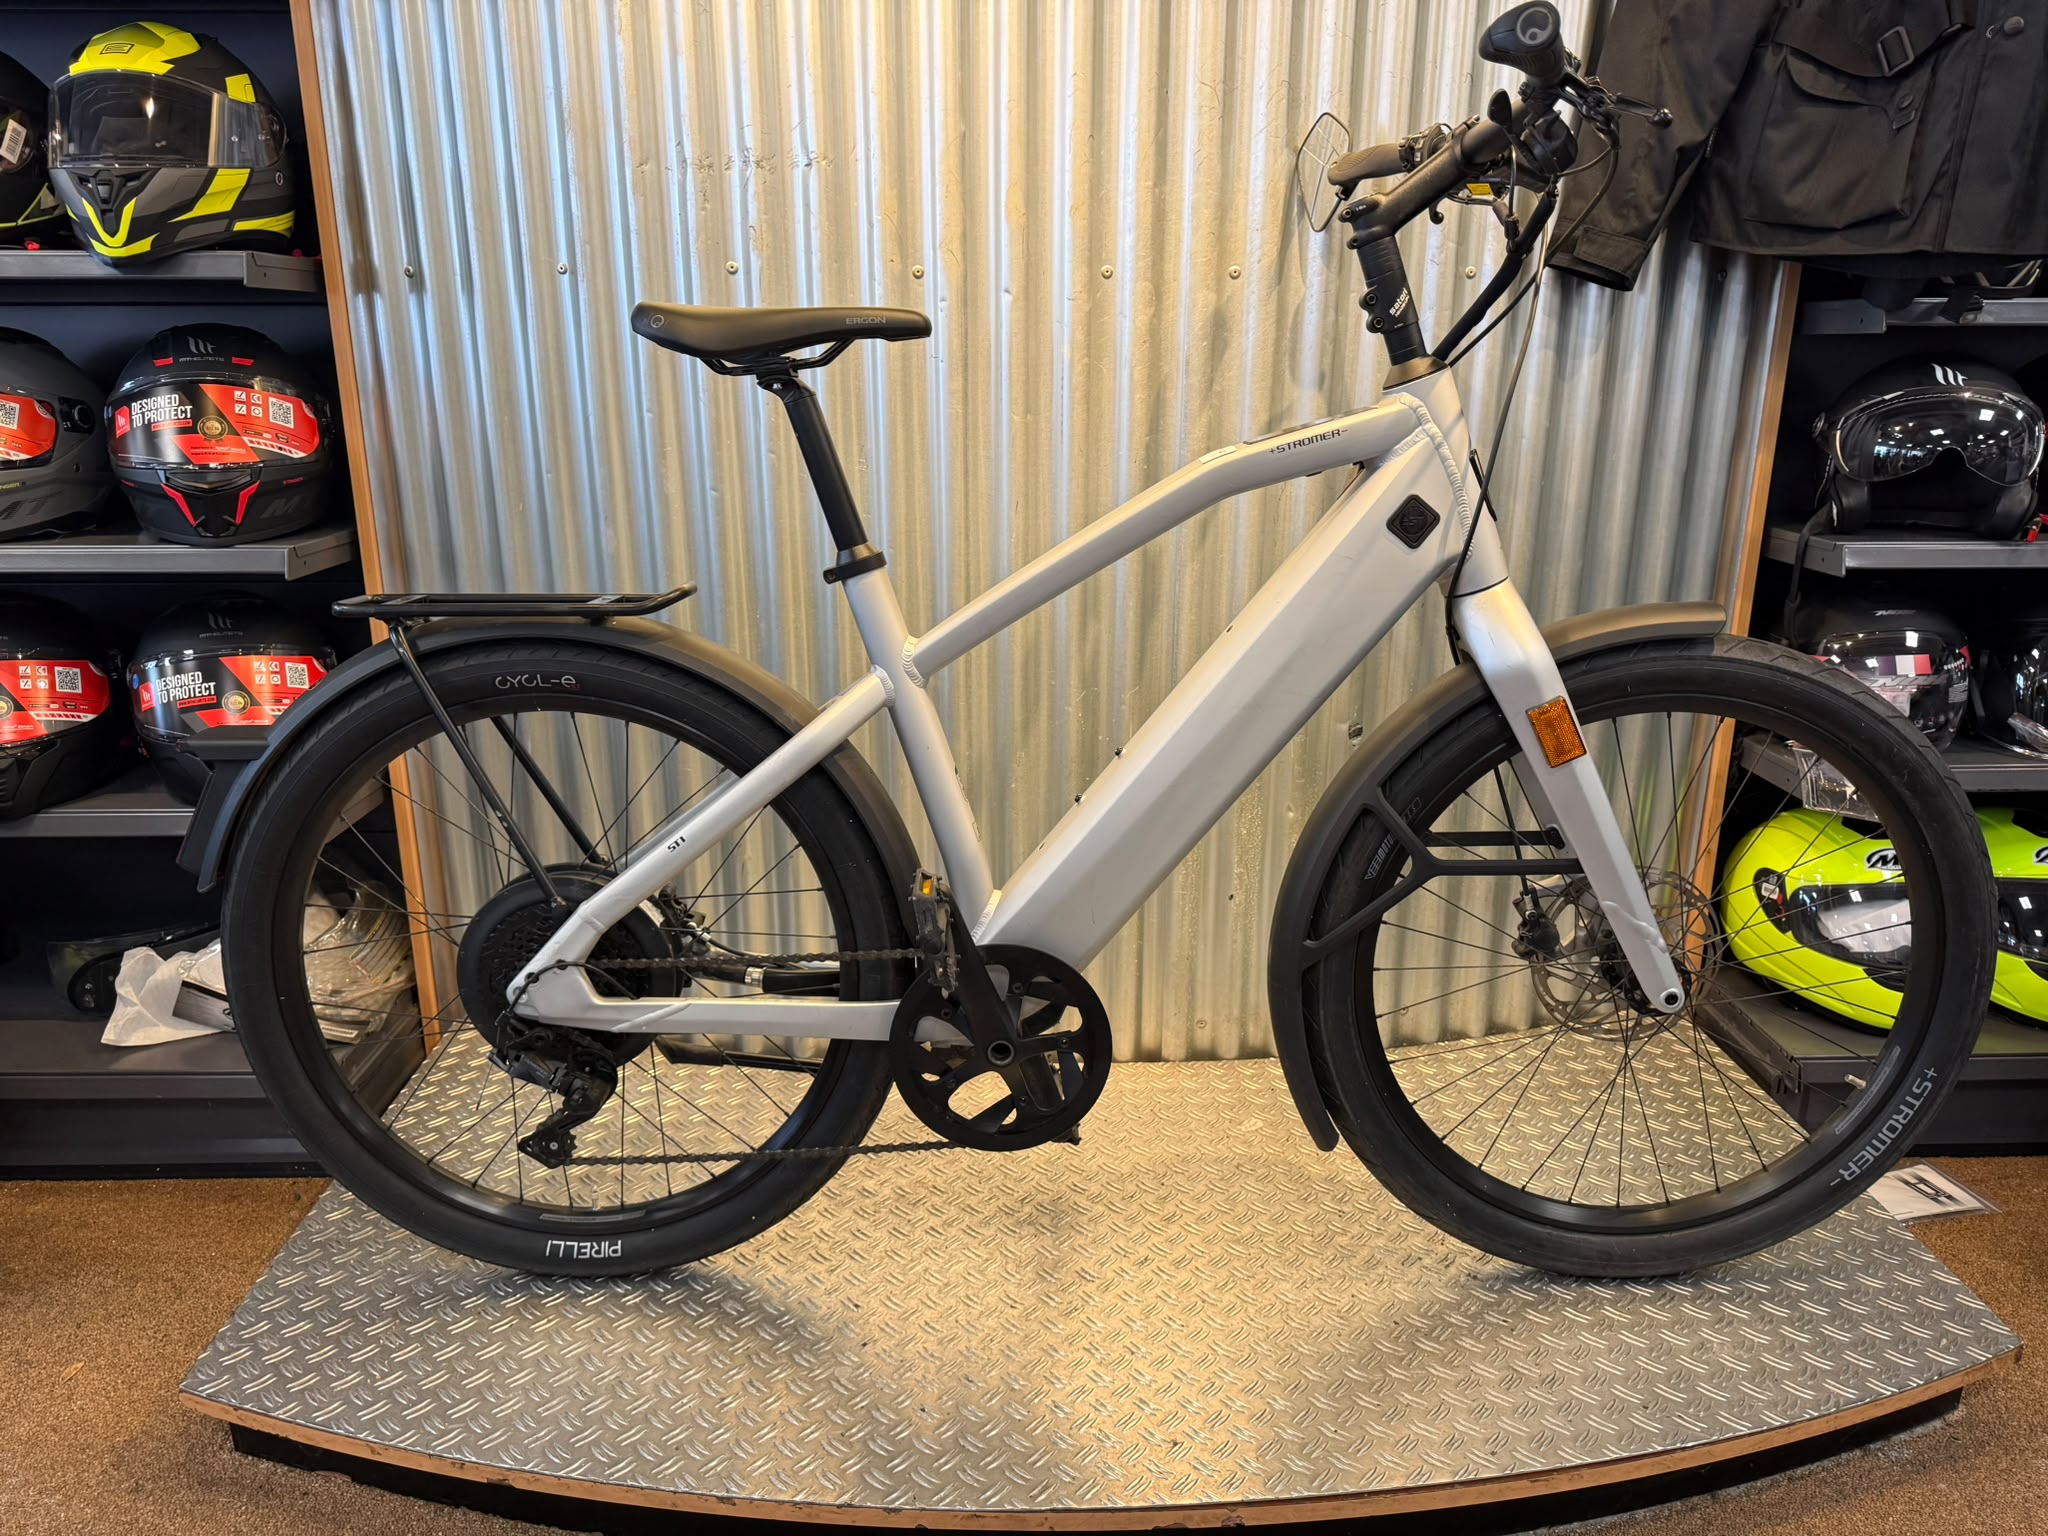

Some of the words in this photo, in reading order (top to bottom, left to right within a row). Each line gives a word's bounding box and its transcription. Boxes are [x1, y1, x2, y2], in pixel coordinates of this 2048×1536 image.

[845, 316, 887, 325] ERGON
[131, 394, 179, 415] DESIGNED
[131, 413, 143, 429] TO
[144, 405, 193, 425] PROTECT
[155, 671, 203, 692] DESIGNED
[157, 690, 169, 705] TO
[169, 682, 216, 702] PROTECT
[545, 1239, 622, 1259] PIRELLI
